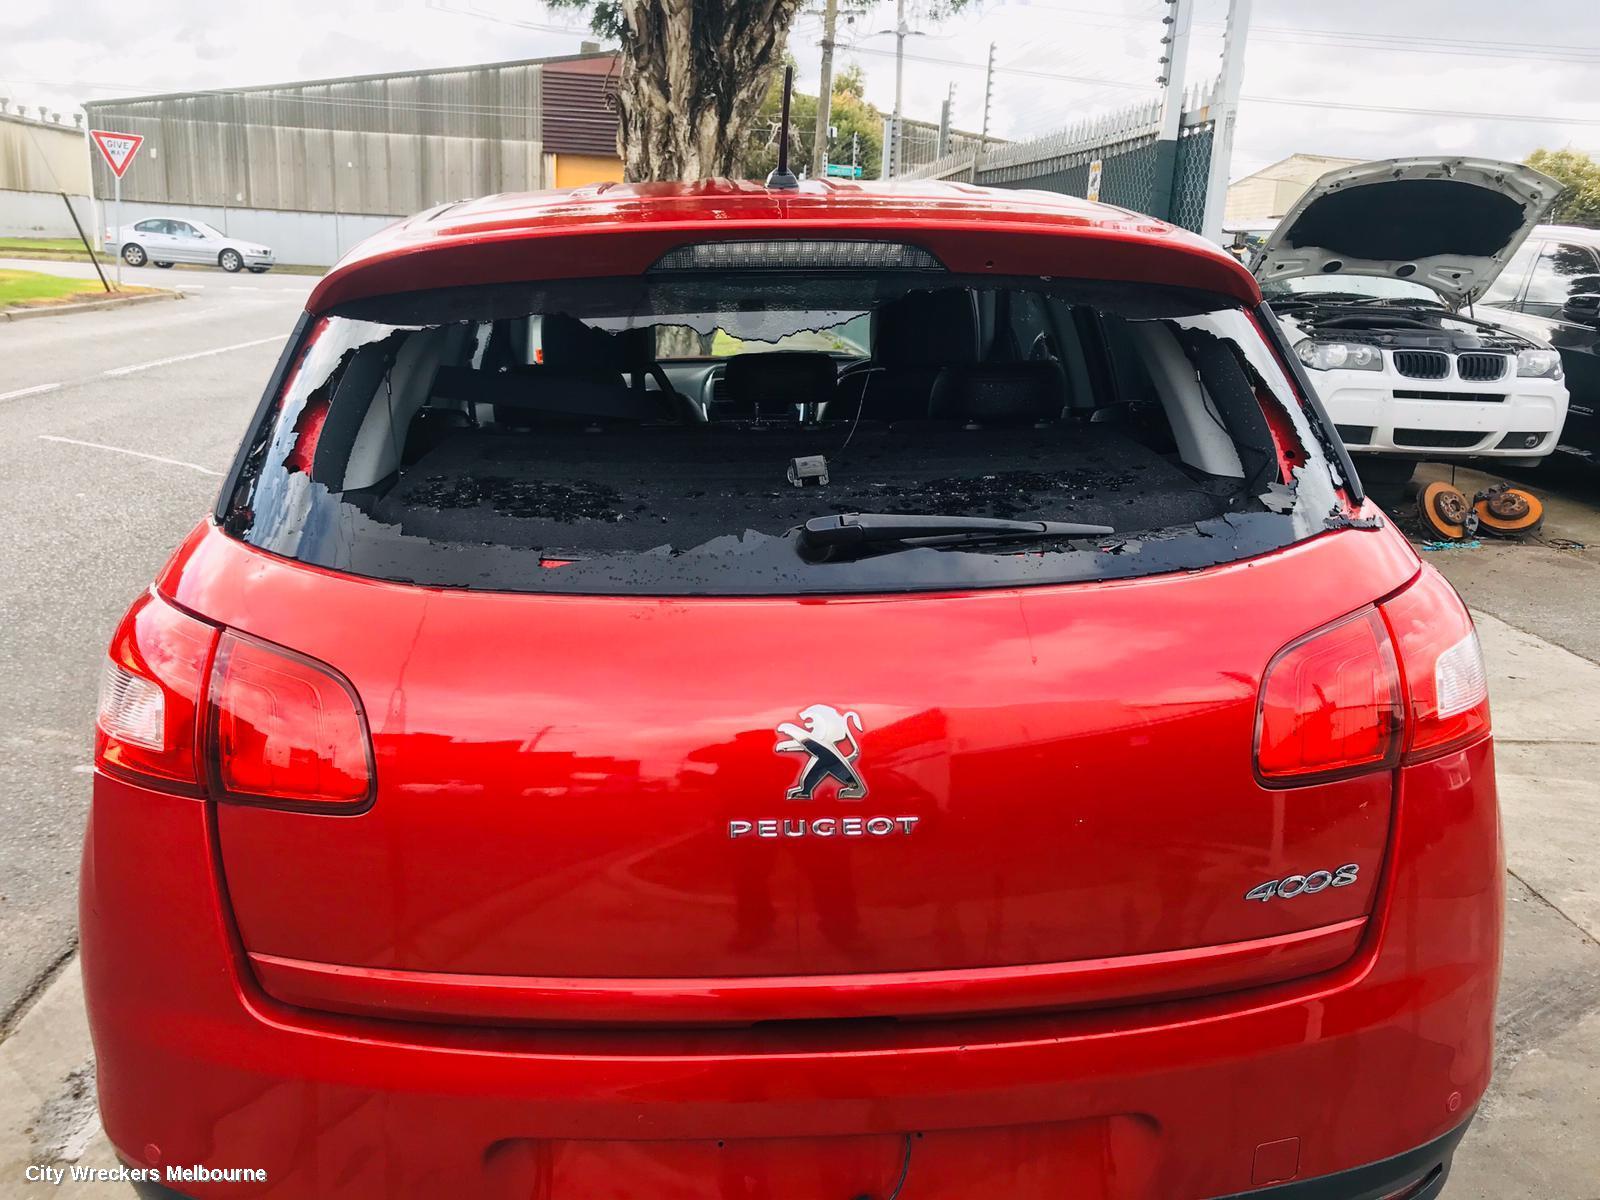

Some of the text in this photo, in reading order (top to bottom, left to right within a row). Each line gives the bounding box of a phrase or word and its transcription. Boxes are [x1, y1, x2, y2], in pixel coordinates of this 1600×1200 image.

[106, 139, 129, 150] GIVE
[729, 816, 919, 839] PEUGEOT
[1245, 863, 1360, 902] 4008
